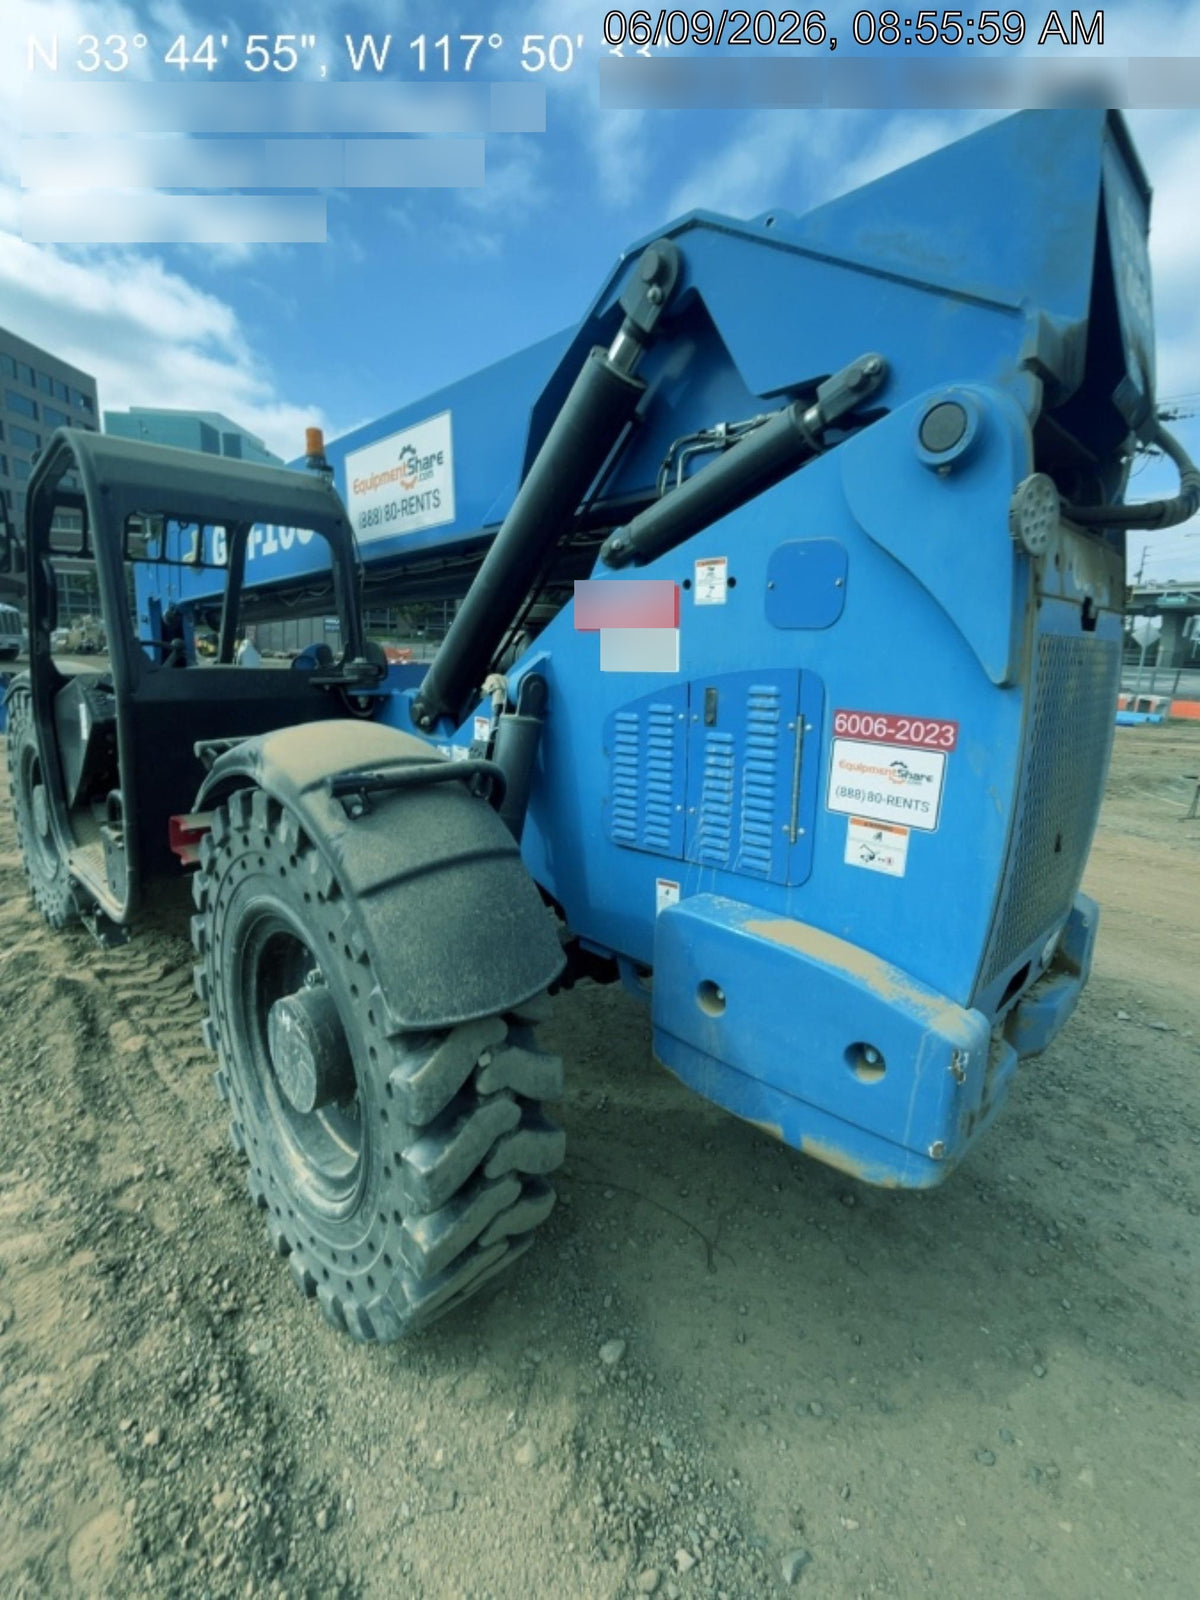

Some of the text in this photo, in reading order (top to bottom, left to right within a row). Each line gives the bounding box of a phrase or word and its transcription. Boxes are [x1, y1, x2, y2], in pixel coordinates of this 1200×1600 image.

[353, 450, 444, 495] EquipmentShare
[834, 713, 955, 747] 6006-2023
[839, 760, 934, 782] EquipmentShare
